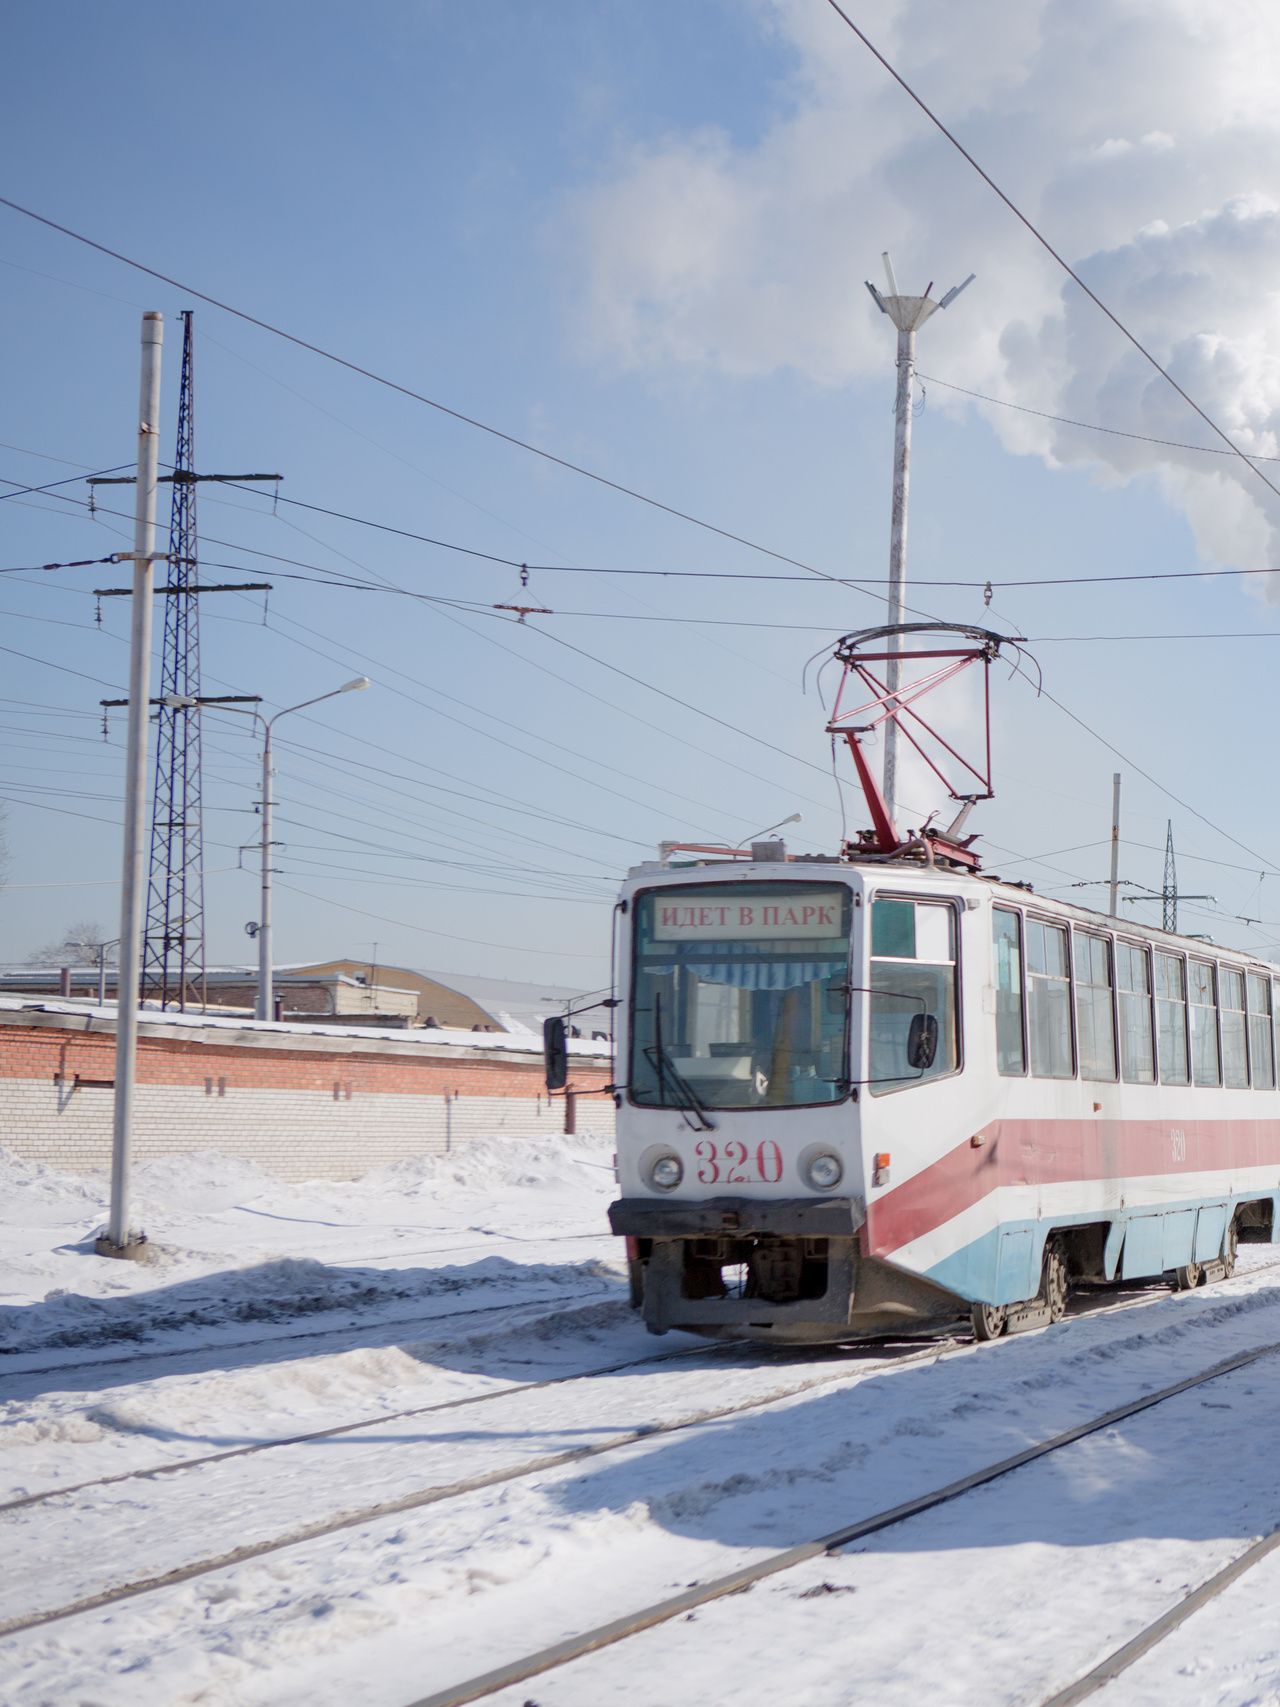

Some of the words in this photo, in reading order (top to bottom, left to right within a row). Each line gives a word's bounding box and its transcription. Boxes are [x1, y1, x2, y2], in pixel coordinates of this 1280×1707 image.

[661, 906, 730, 928] ИДЕТ
[739, 906, 754, 926] В
[762, 905, 836, 926] ПАРК
[695, 1140, 783, 1184] 320
[1170, 1128, 1186, 1162] 320
